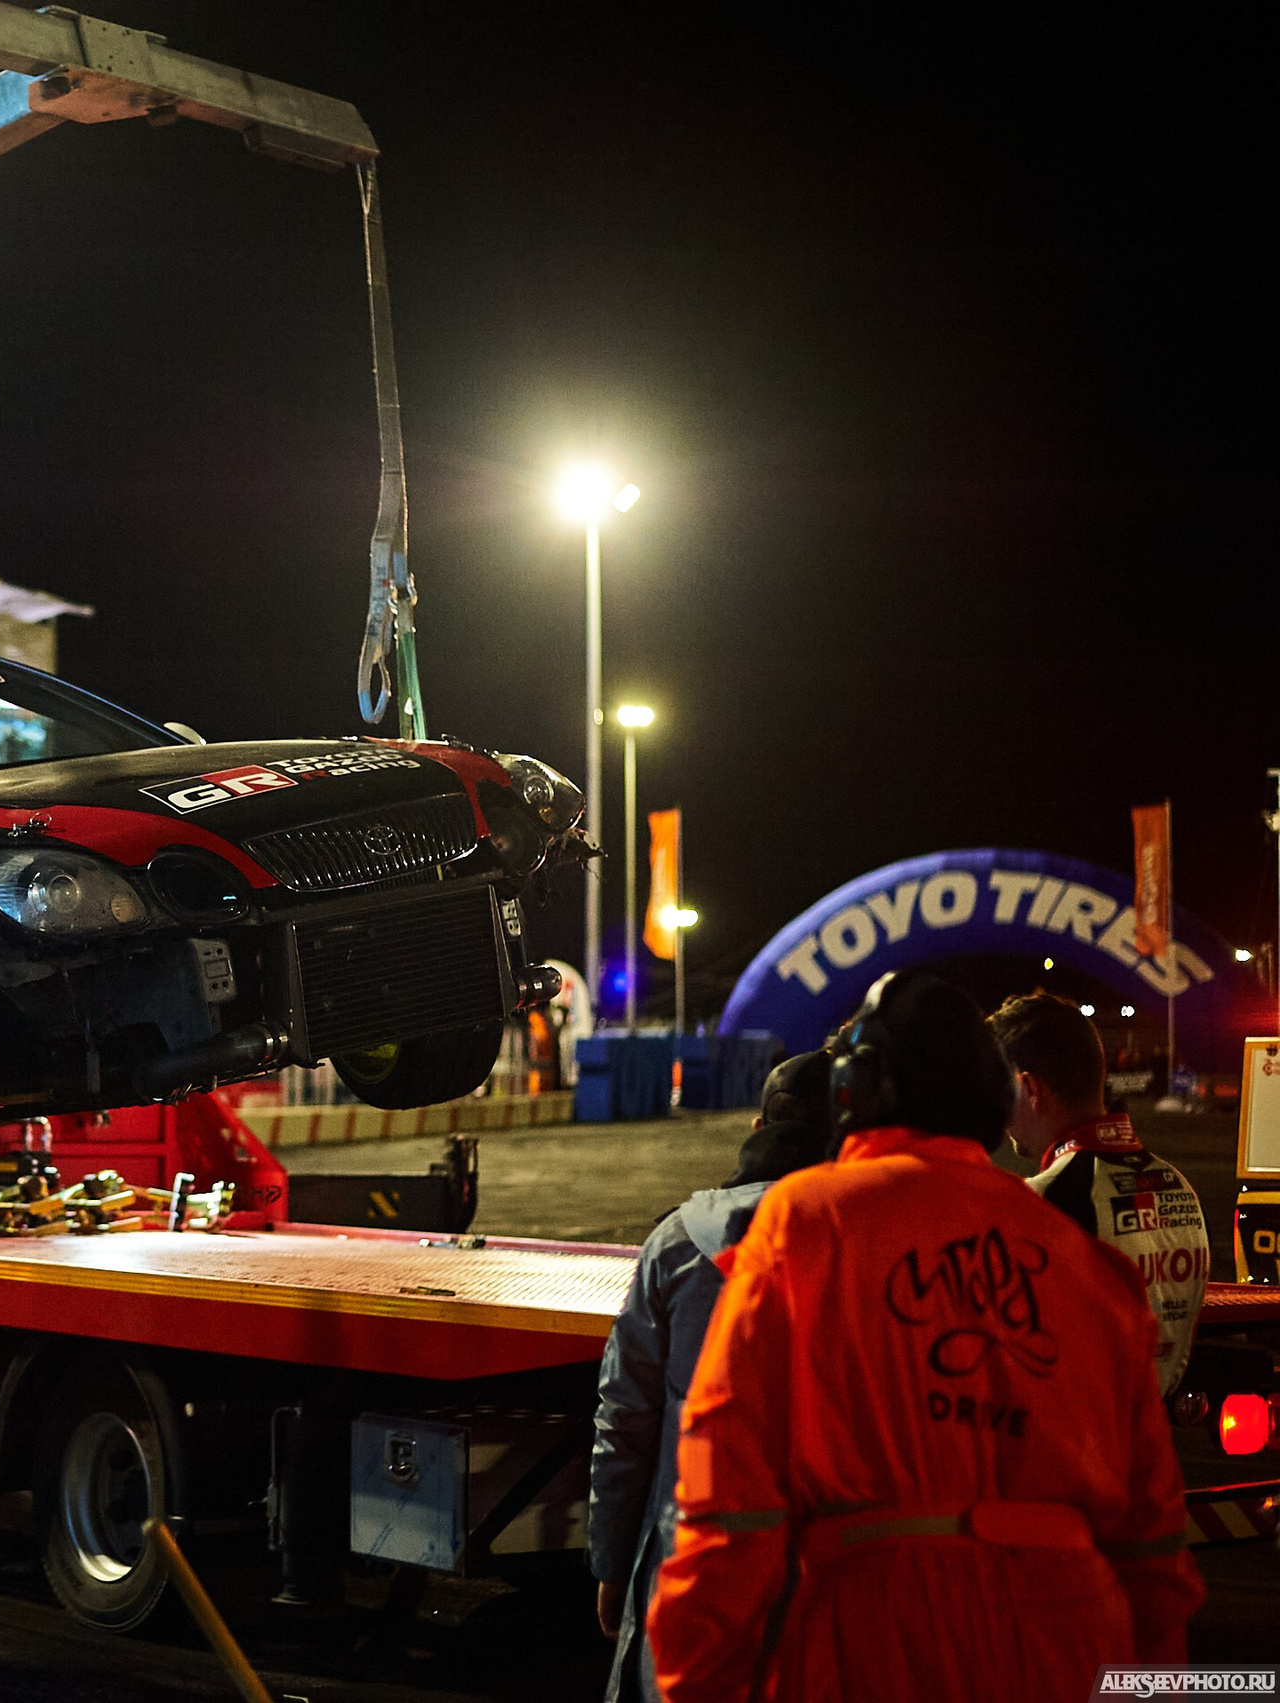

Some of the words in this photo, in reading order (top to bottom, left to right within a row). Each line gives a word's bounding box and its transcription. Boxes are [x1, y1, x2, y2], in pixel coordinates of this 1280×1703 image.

[284, 753, 404, 774] GAZOO
[300, 759, 421, 781] Racing
[167, 771, 290, 809] GR
[776, 870, 977, 997] TOYO
[1116, 1208, 1158, 1234] GR
[1160, 1215, 1202, 1230] Racing
